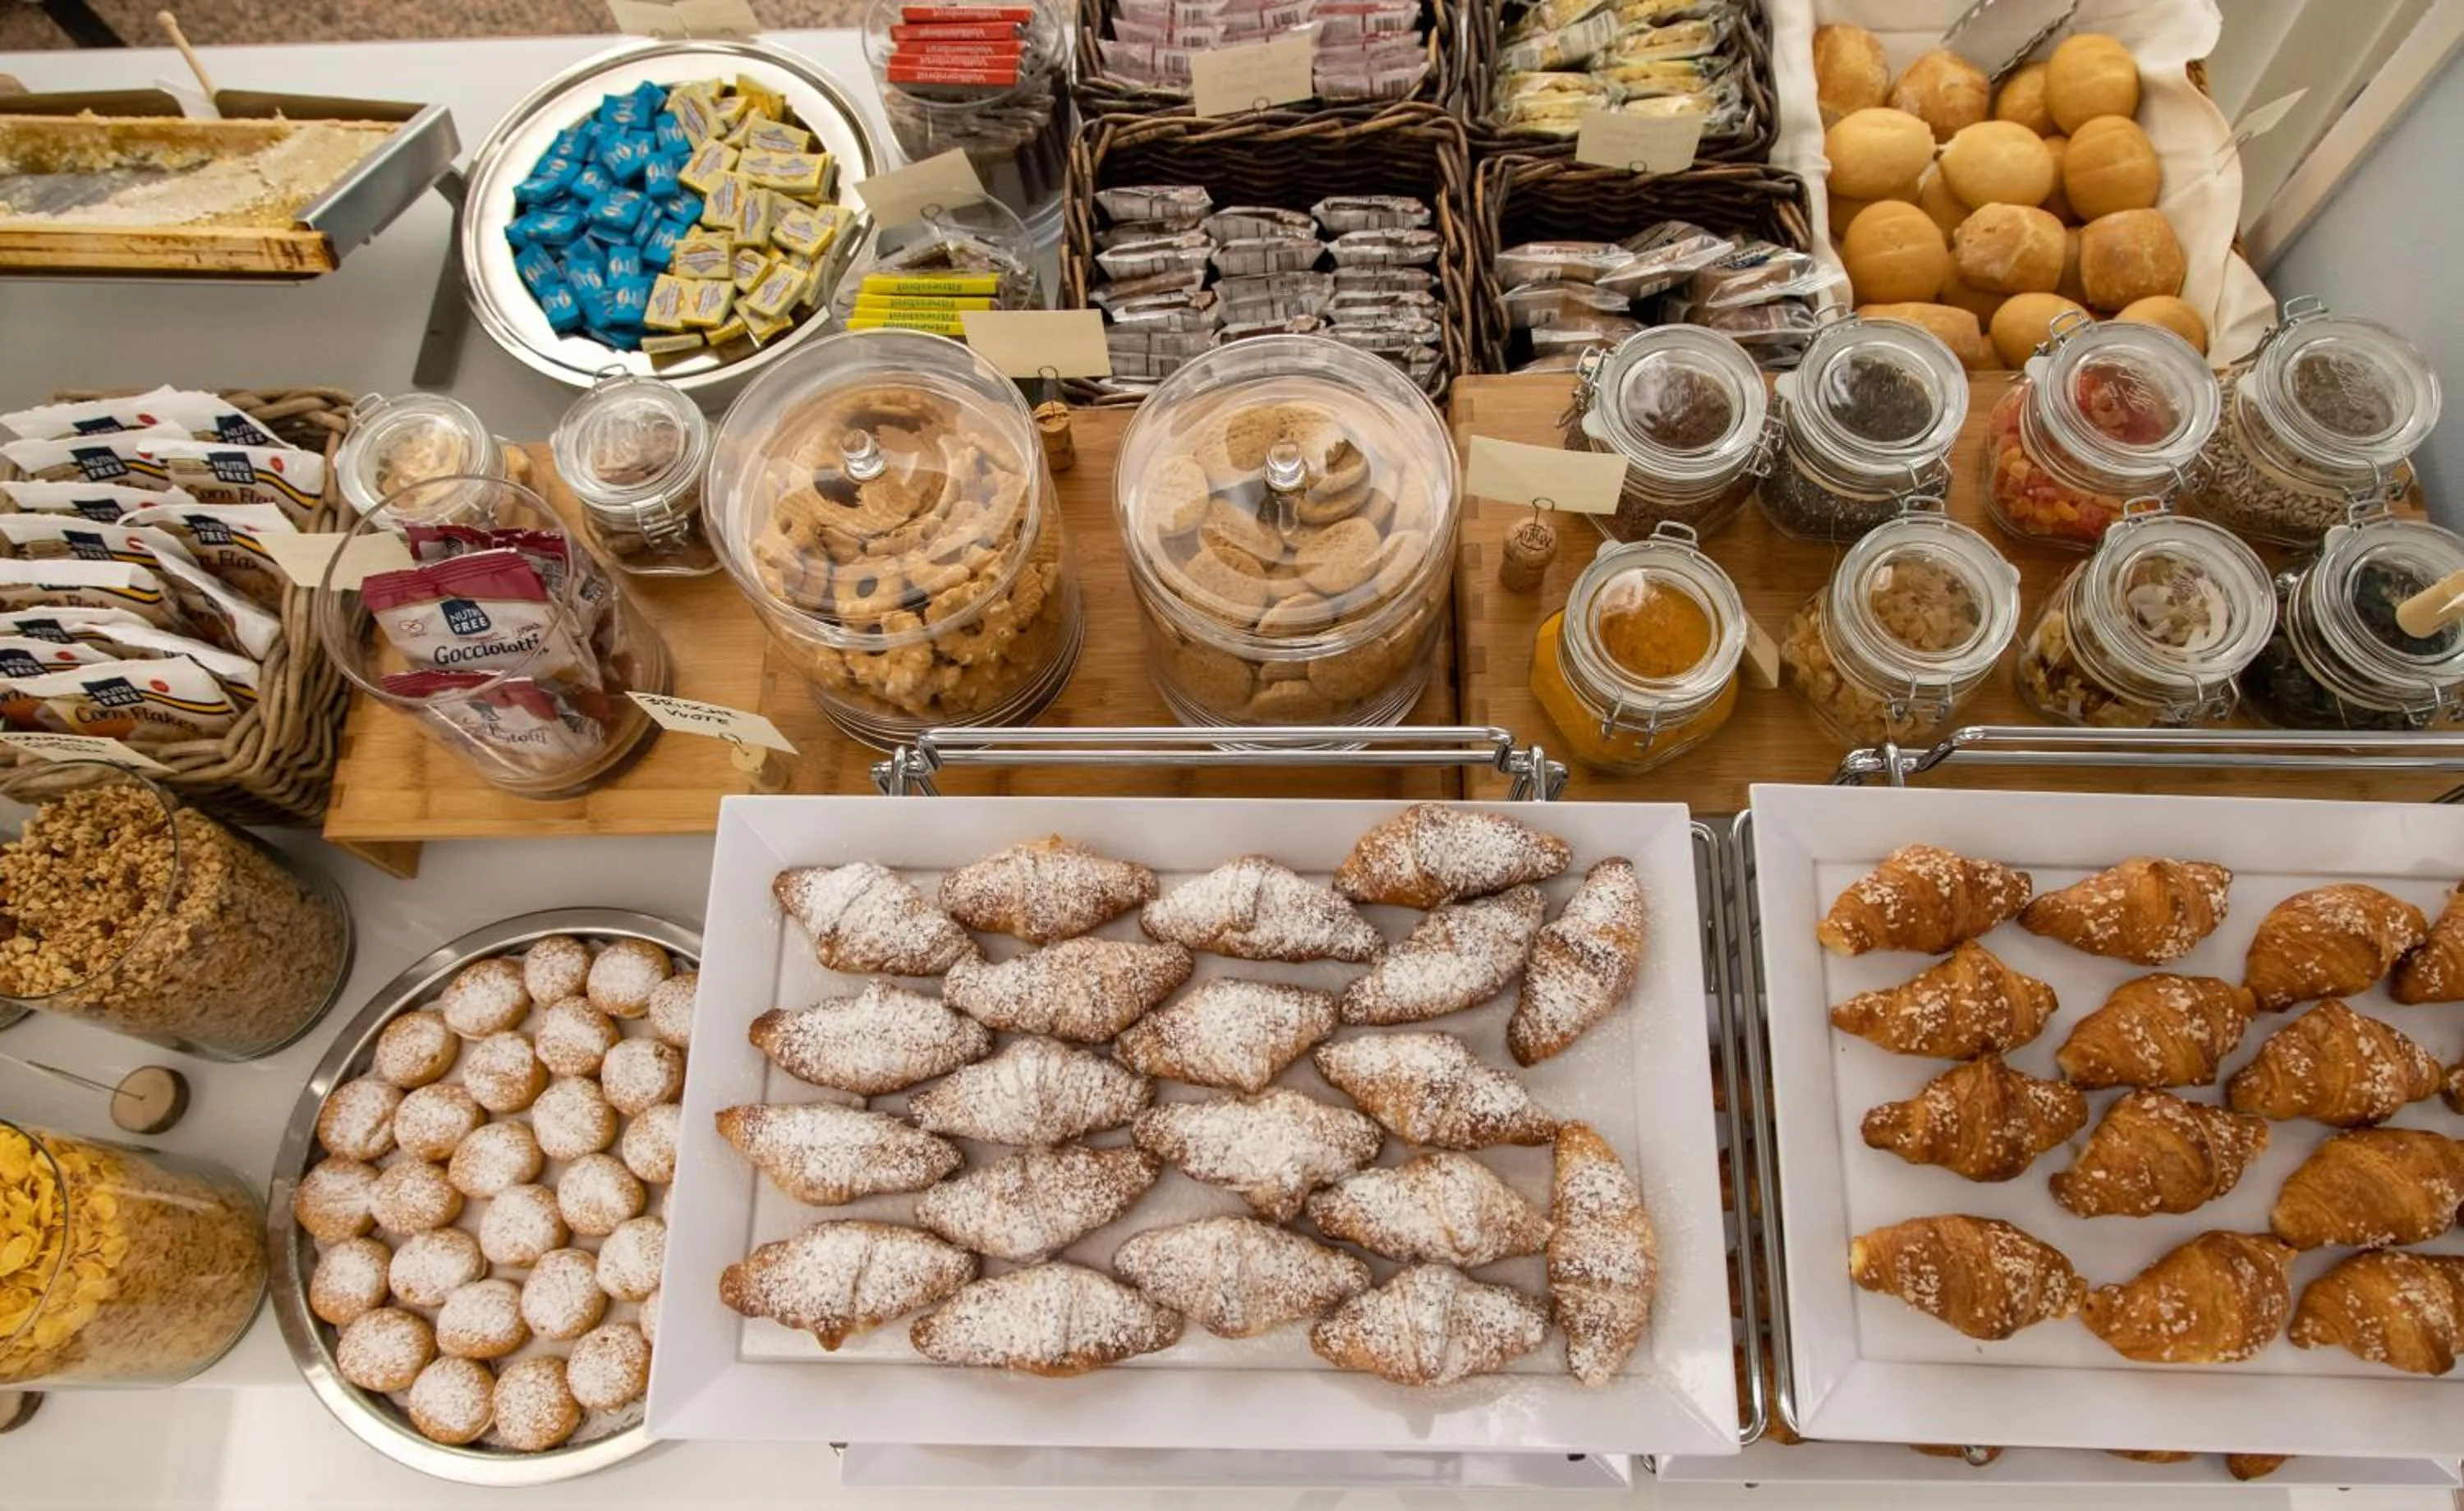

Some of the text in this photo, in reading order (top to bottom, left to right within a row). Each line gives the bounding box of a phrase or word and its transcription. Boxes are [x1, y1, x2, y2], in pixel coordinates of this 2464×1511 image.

[917, 70, 986, 81] Vollkornbrot
[896, 282, 963, 292] Fitnessbrot
[90, 463, 125, 481] FREE
[214, 459, 249, 472] NUTRI
[218, 471, 254, 483] FREE
[453, 616, 487, 634] FREE
[434, 633, 540, 665] Gocciolotti
[94, 685, 132, 698] NUTRI
[102, 692, 140, 705] FREE
[75, 705, 202, 733] Corn Flakes
